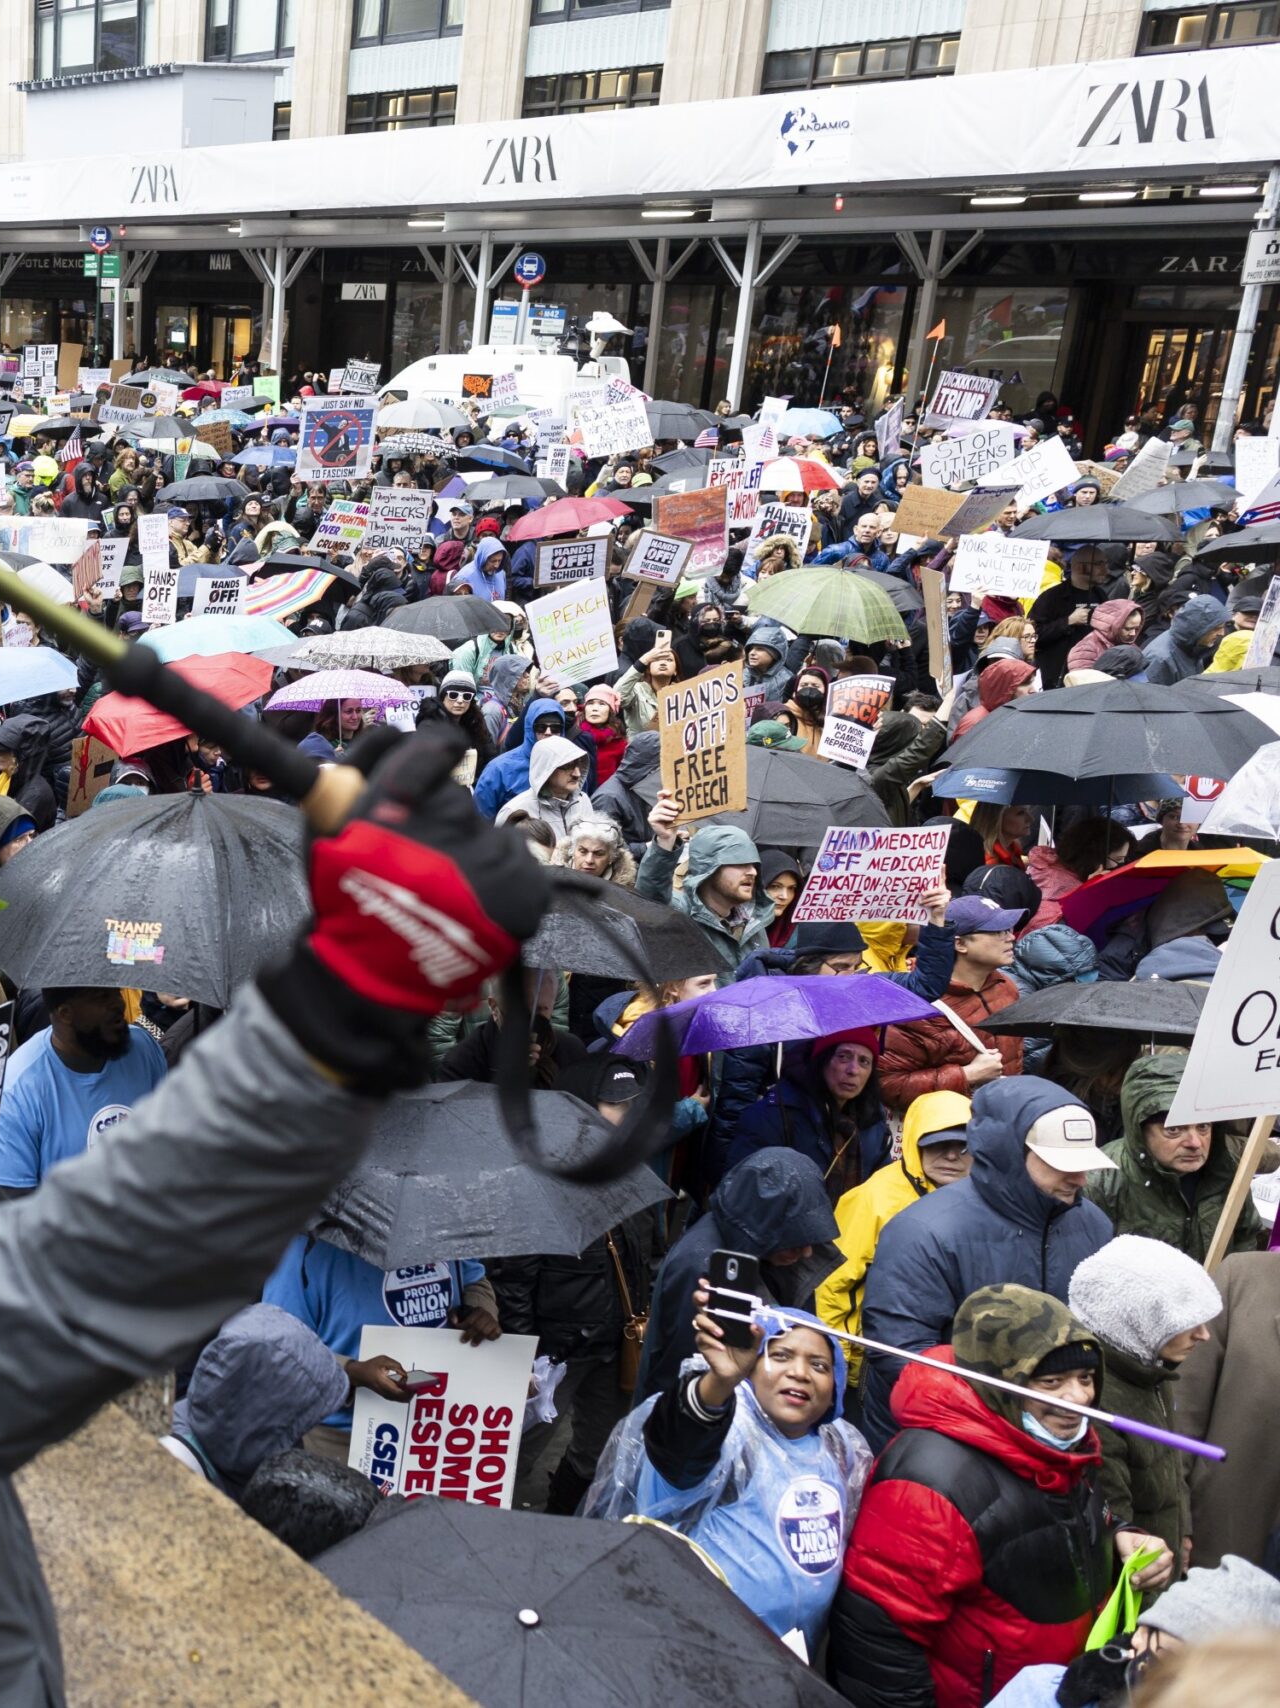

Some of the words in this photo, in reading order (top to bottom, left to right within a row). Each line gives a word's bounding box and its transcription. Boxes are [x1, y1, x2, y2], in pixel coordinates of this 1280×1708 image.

[1077, 74, 1216, 148] ZARA
[482, 133, 558, 185] ZARA
[129, 164, 179, 204] ZARA
[53, 256, 83, 268] MEXIC
[210, 254, 231, 270] NAYA
[354, 284, 377, 299] ZARA
[345, 369, 358, 381] NO
[612, 378, 636, 396] STOP
[321, 400, 338, 409] JUST
[339, 400, 353, 409] SAY
[354, 399, 365, 408] NO
[476, 394, 520, 414] MERICA
[935, 387, 986, 419] TRUMP
[936, 429, 1001, 460] STOP
[930, 445, 1008, 475] CITIZENS
[1001, 451, 1042, 485] STOP
[312, 469, 321, 478] TO
[710, 471, 743, 488] RIGHT
[940, 461, 1000, 485] UNITED
[400, 494, 426, 505] eating
[354, 504, 369, 515] HAV
[380, 505, 430, 520] CHECKS!
[764, 505, 808, 524] HANDS
[318, 524, 340, 535] OVER
[336, 514, 368, 528] FIGHTIN
[397, 524, 422, 535] eating
[756, 519, 807, 546] OFF!
[316, 538, 351, 550] CRUMBS
[372, 534, 425, 550] BALANCES!
[552, 544, 595, 556] HANDS
[651, 538, 680, 553] HANDS
[961, 538, 988, 554] YOUR
[994, 542, 1044, 559] SILENCE
[552, 553, 595, 570] OFF!
[646, 549, 676, 565] OFF!
[977, 557, 1003, 569] WILL
[1011, 561, 1036, 574] NOT
[550, 567, 595, 581] SCHOOLS
[651, 562, 670, 574] COURTS
[149, 570, 177, 587] HANDS
[211, 579, 240, 589] HANDS
[965, 572, 1005, 586] SAVE
[1012, 578, 1037, 592] YOU
[146, 586, 172, 603] OFF
[207, 589, 240, 605] OFF!
[535, 594, 608, 634] IMPEACH
[548, 619, 587, 645] THE
[543, 631, 610, 671] ORANGE
[833, 678, 892, 692] STUDENTS
[665, 672, 739, 726] HANDS
[832, 686, 890, 708] FIGHT
[832, 700, 882, 725] BACK
[683, 709, 727, 753] OFF!
[834, 722, 847, 732] NO
[847, 725, 865, 737] MORE
[834, 731, 864, 747] CAMPUS
[673, 744, 727, 790] FREE
[674, 775, 729, 814] SPEECH
[826, 829, 880, 851] HANDS
[874, 831, 947, 851] MEDICAID
[817, 852, 862, 872] OFF
[867, 854, 941, 872] MEDICARE
[862, 894, 920, 907] SPEECH
[858, 907, 896, 920] PUBLIC
[105, 918, 163, 933] THANKS
[396, 1262, 437, 1280] CSEA
[404, 1283, 441, 1300] PROUD
[395, 1291, 450, 1318] UNION
[403, 1308, 447, 1326] MEMBER
[404, 1372, 449, 1501] RESPE
[790, 1526, 839, 1553] UNION
